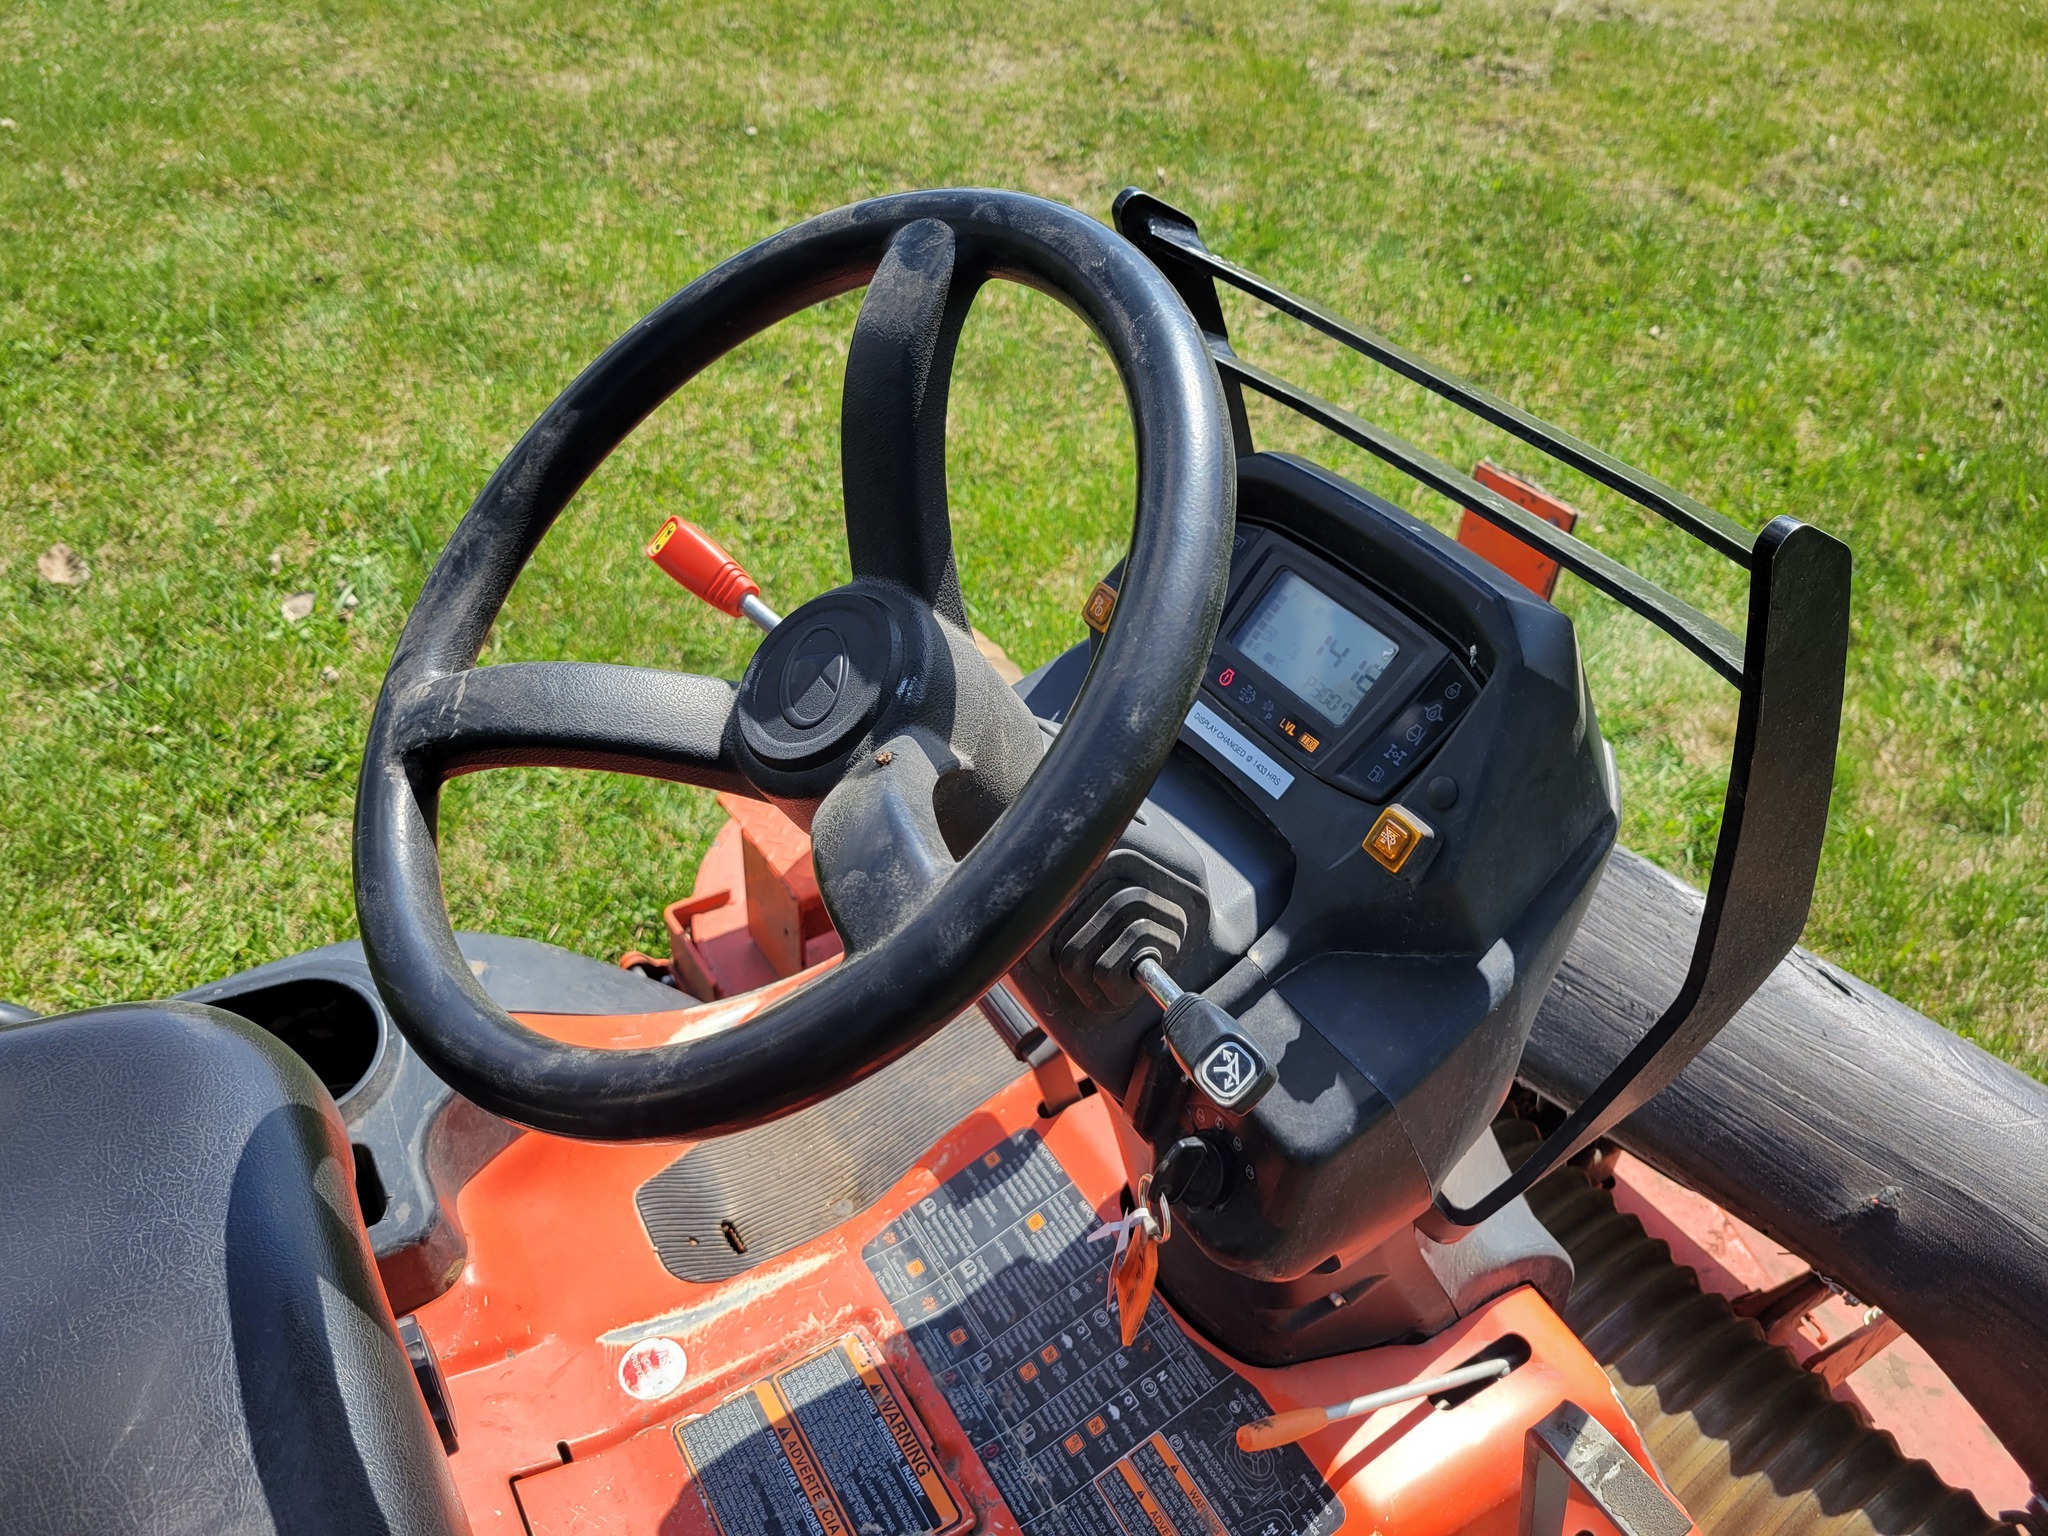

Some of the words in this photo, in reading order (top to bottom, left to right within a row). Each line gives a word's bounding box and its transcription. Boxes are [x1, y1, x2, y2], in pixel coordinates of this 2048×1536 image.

[1277, 716, 1299, 737] LVL
[1191, 711, 1219, 735] DISPLAY
[1213, 729, 1248, 758] CHANGED
[1250, 759, 1269, 776] 1433
[1264, 770, 1283, 787] HRS
[971, 1383, 991, 1408] NOTE
[850, 1372, 863, 1387] TO
[857, 1386, 879, 1415] AVOID
[873, 1414, 906, 1464] PERSONAL
[900, 1463, 925, 1499] INJURY
[875, 1393, 933, 1478] WARNING
[764, 1428, 783, 1455] PARA
[777, 1455, 801, 1490] EVITAR
[794, 1490, 824, 1536] LESIONES
[1194, 1474, 1211, 1495] BRAKE
[1208, 1494, 1226, 1518] FRENO
[1220, 1469, 1237, 1491] LEVER
[1299, 1471, 1317, 1494] BRAKE
[1314, 1492, 1333, 1517] FRENO
[1227, 1495, 1245, 1519] FRENO
[1300, 1511, 1320, 1536] AVANCE
